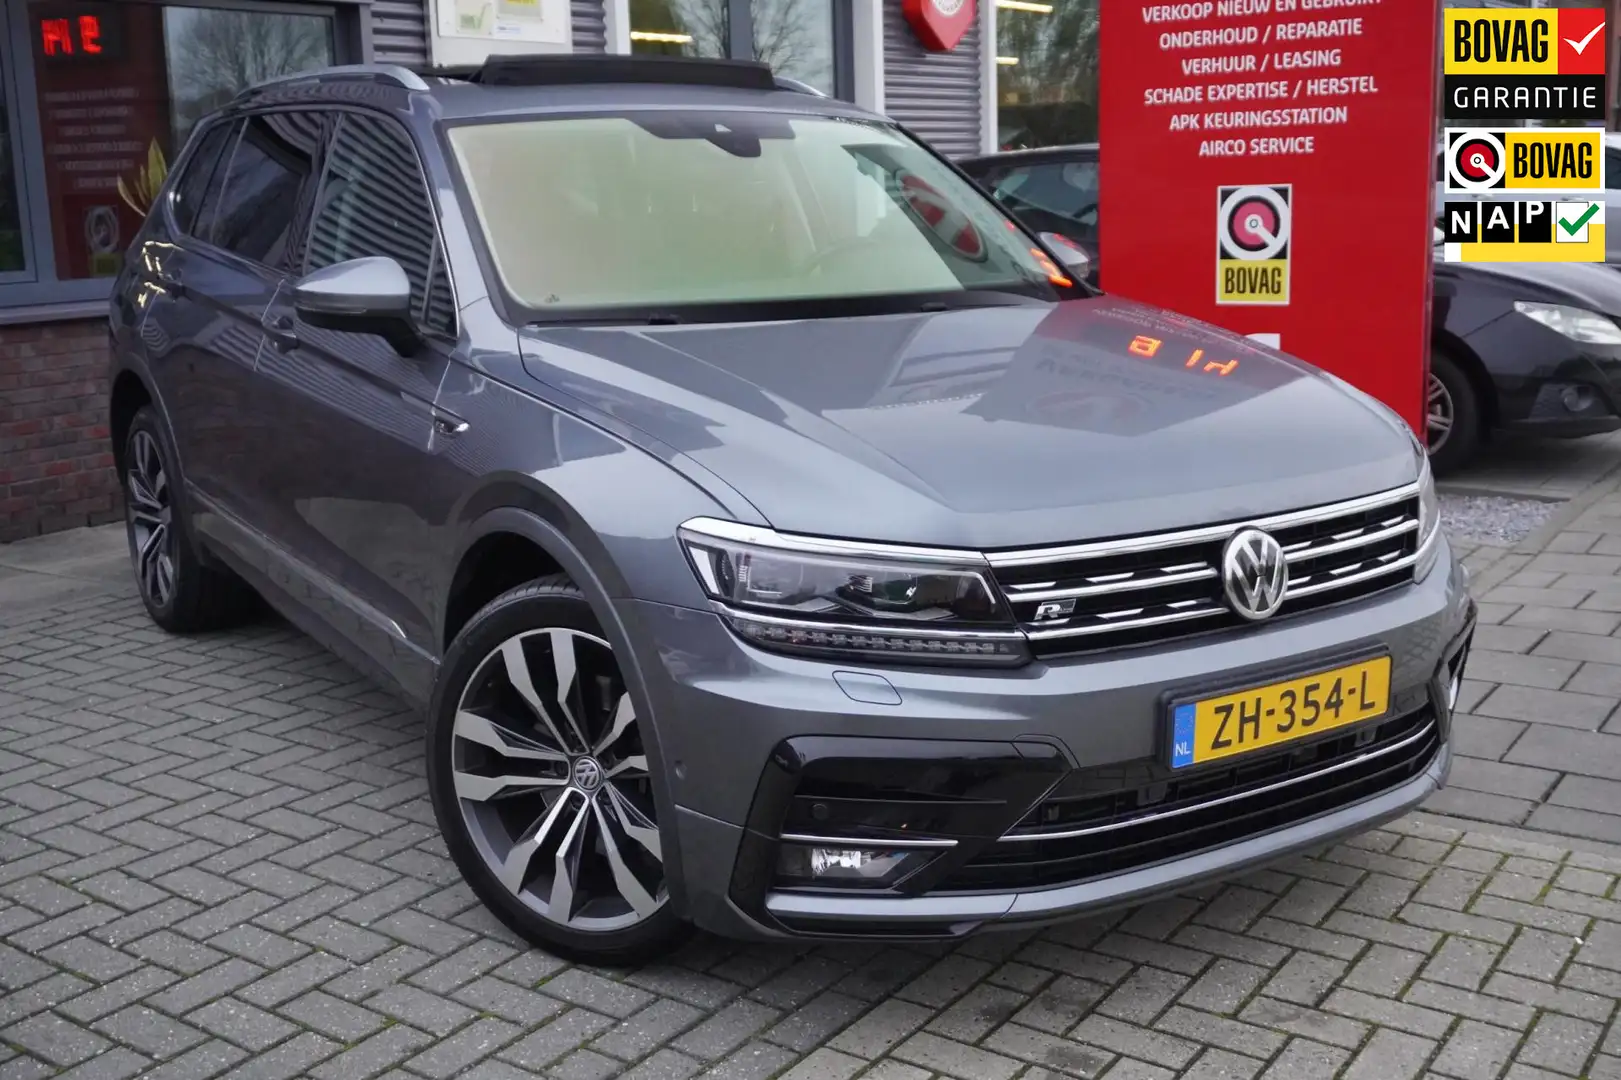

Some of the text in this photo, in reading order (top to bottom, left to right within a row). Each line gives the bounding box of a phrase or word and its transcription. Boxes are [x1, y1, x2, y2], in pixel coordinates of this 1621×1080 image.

[1142, 5, 1212, 22] VERKOOP
[1217, 0, 1268, 16] NIEUW
[1275, 0, 1297, 11] EN
[1159, 27, 1258, 49] ONDERHOUD
[1276, 18, 1362, 41] REPARATIE
[1182, 54, 1256, 75] VERHUUR
[1274, 49, 1341, 69] LEASING
[1144, 85, 1203, 105] SCHADE
[1207, 80, 1289, 102] EXPERTISE
[1306, 76, 1378, 96] HERSTEL
[1169, 106, 1347, 131] APK KEURINGSSTATION
[1199, 136, 1315, 157] AIRCO SERVICE
[1224, 266, 1282, 295] BOVAG
[1211, 671, 1376, 751] ZH-354-L
[1175, 741, 1191, 757] NL
